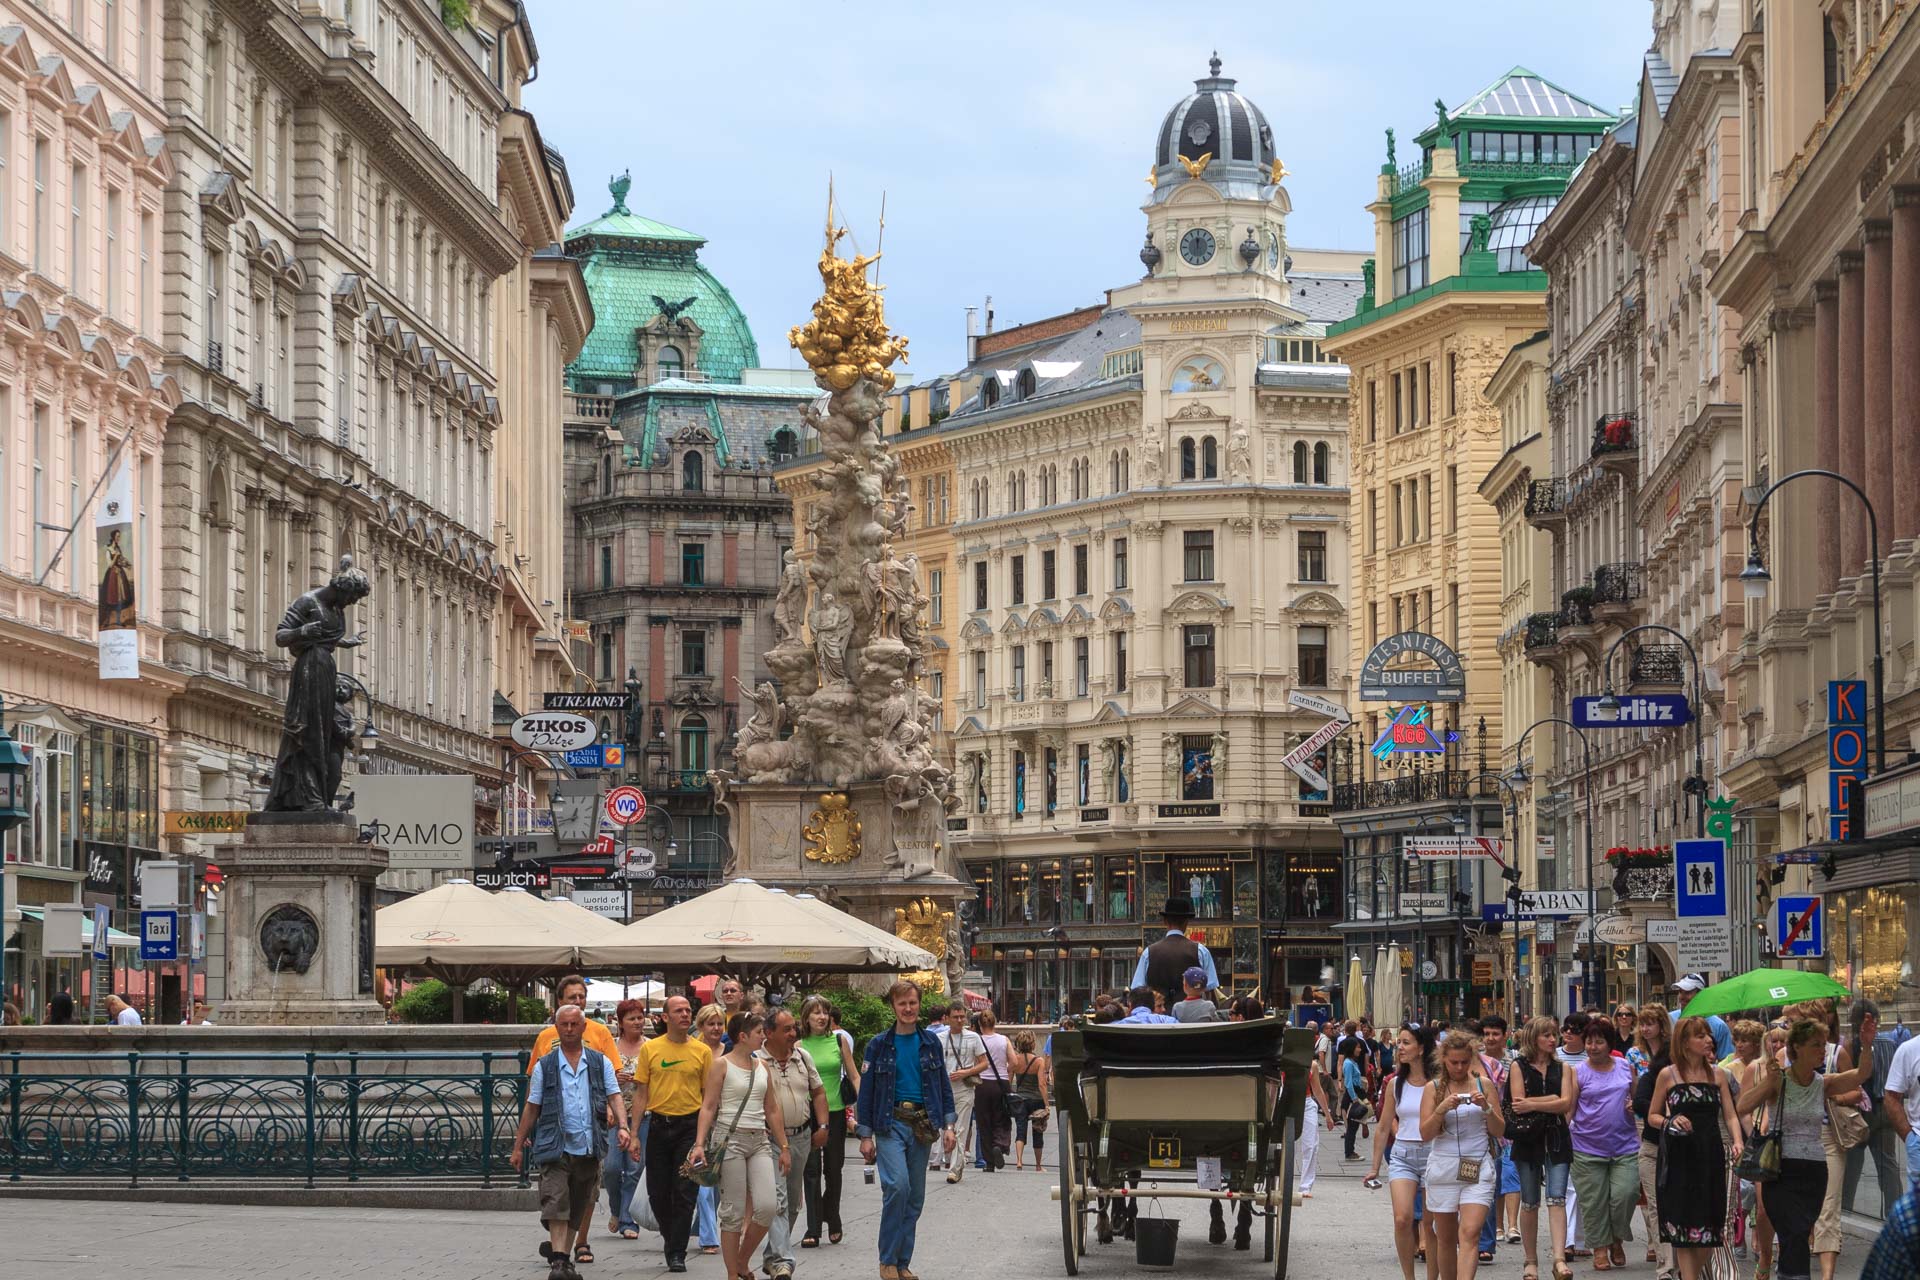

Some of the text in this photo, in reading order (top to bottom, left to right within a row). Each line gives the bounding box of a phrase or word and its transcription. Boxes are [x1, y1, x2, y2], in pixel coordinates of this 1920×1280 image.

[1381, 671, 1443, 684] BUFFET
[1586, 698, 1674, 721] Brlitz
[521, 719, 587, 734] ZIKOS
[529, 732, 576, 748] Pelze
[1286, 719, 1343, 768] FLEDERMAUS
[617, 799, 637, 812] VVD
[1174, 807, 1197, 815] BRAUN
[583, 896, 619, 904] world of
[1518, 893, 1584, 912] HABAN
[148, 921, 169, 935] Taxi
[1599, 925, 1625, 935] Albin
